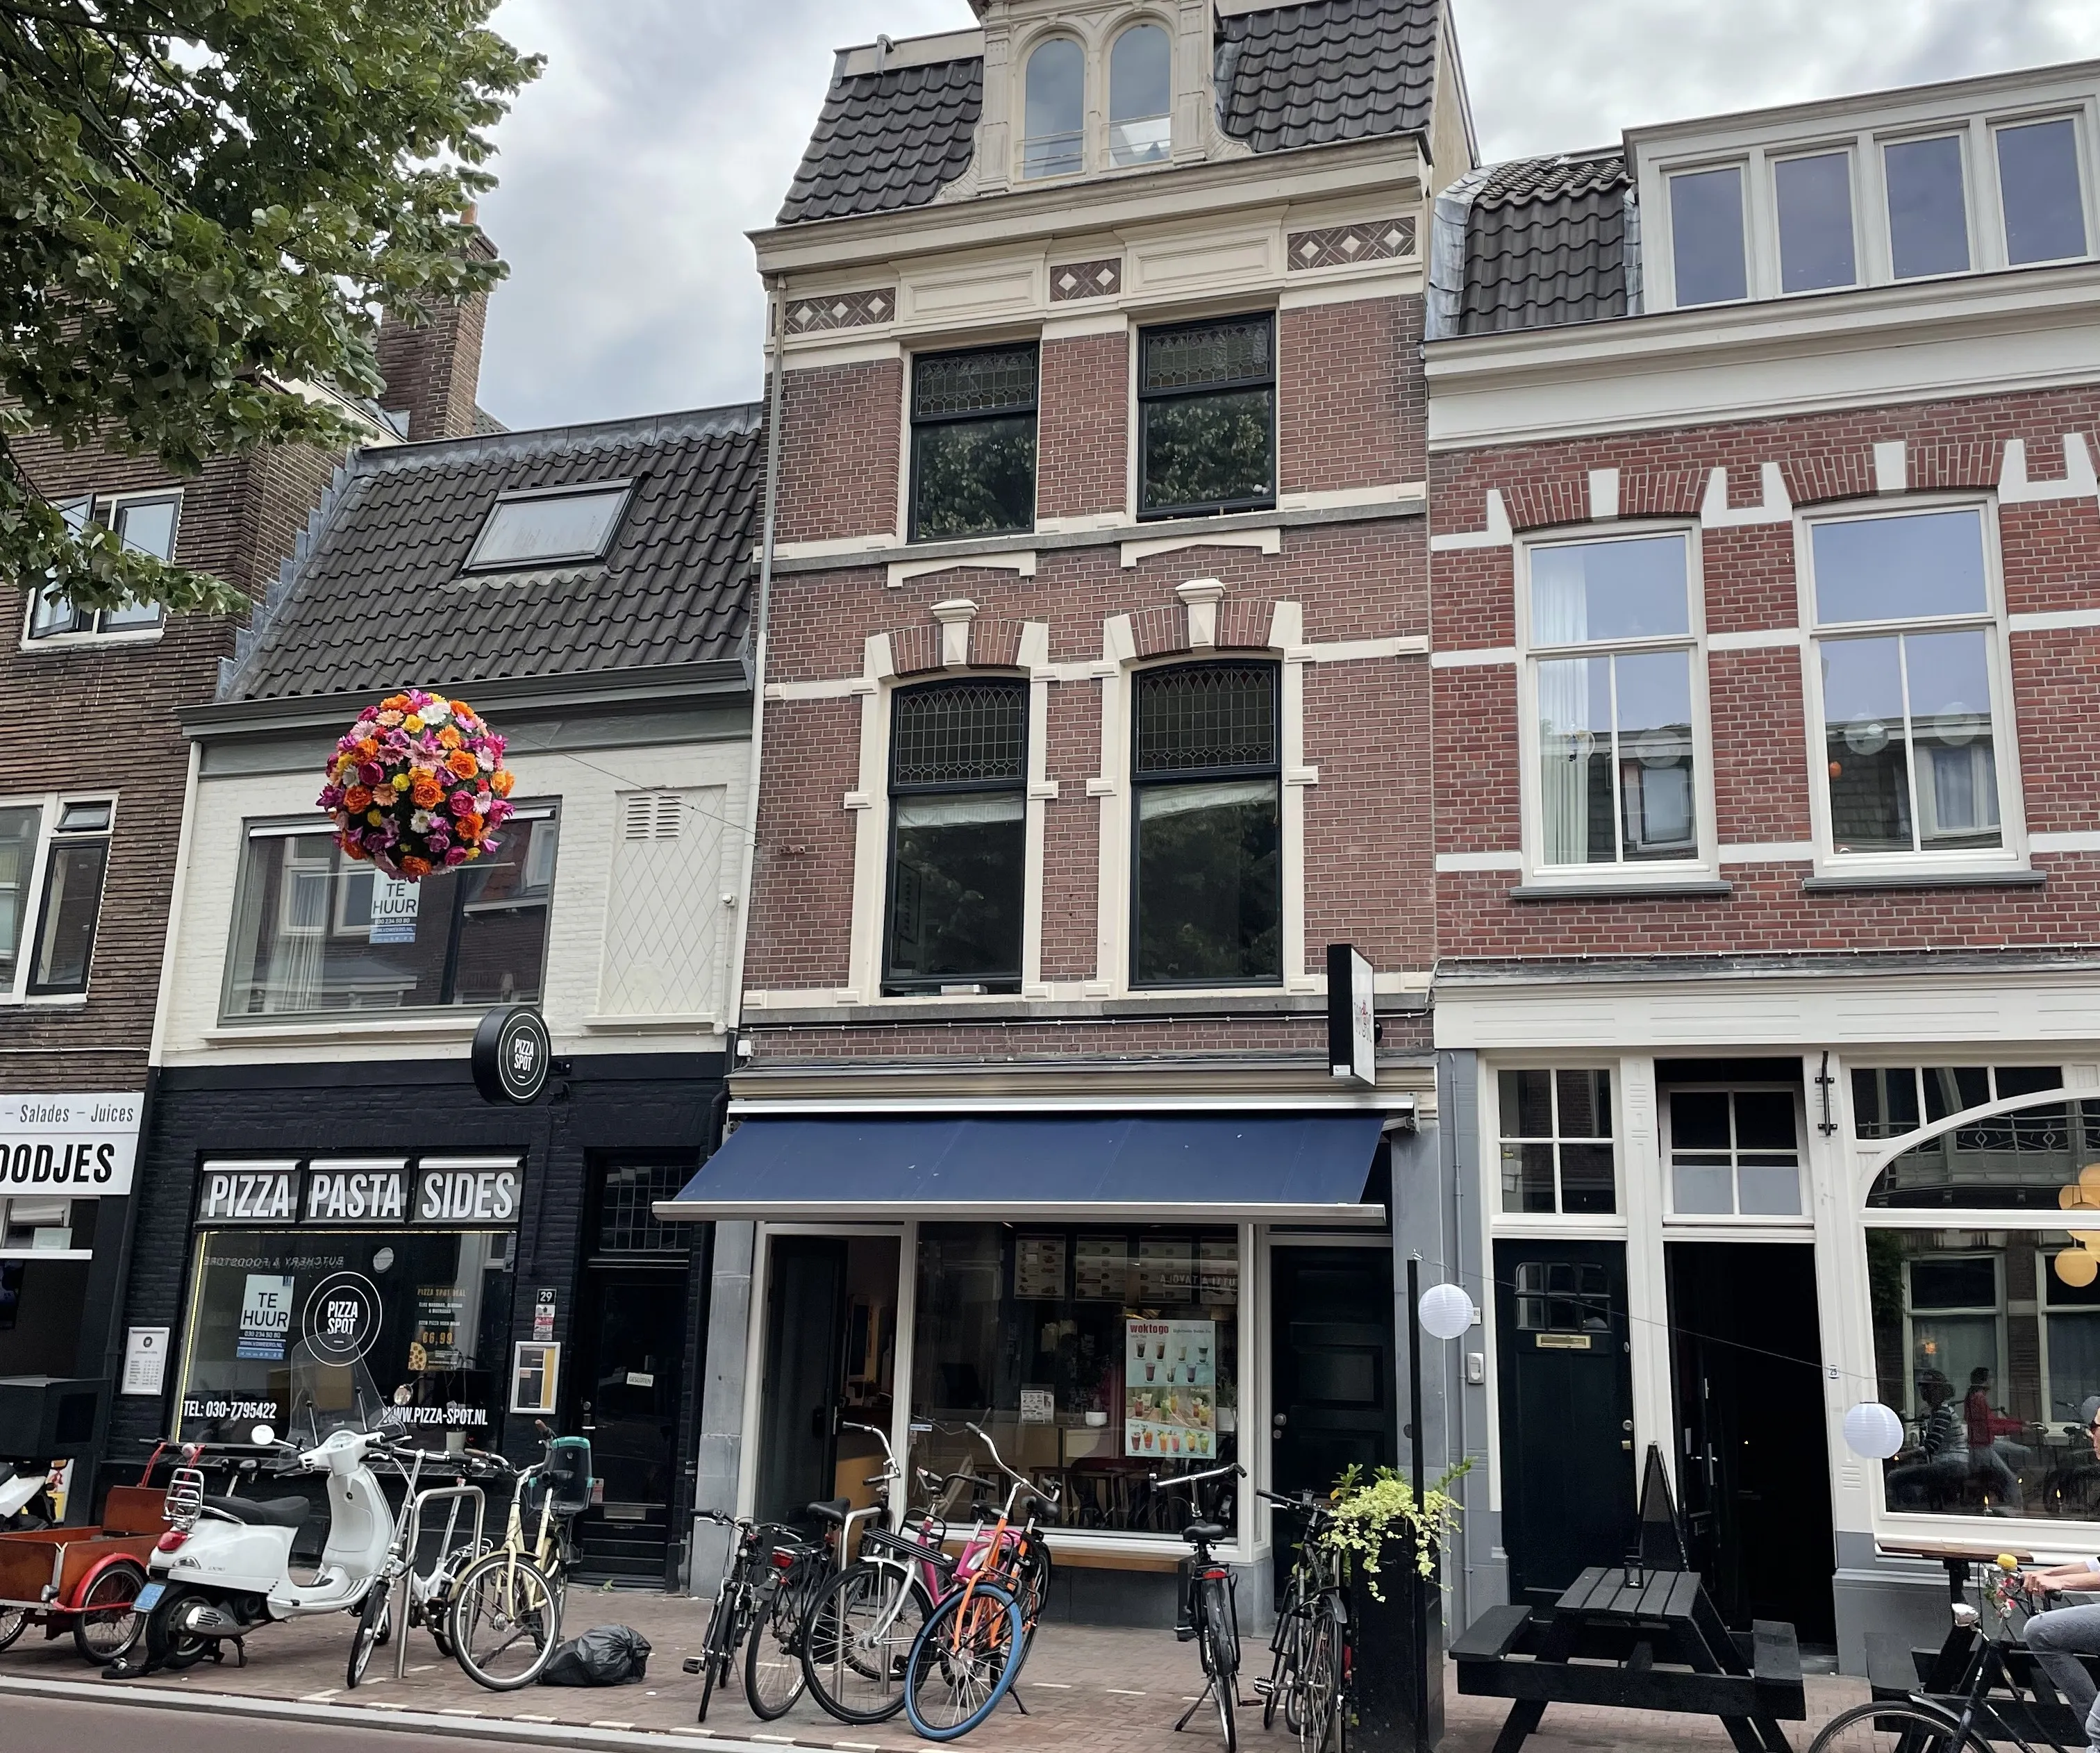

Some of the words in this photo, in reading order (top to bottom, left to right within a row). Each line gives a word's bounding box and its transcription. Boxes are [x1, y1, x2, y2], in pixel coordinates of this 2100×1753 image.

[386, 883, 406, 897] TE
[373, 899, 417, 915] HUUR
[514, 1038, 534, 1057] PIZZA
[514, 1054, 533, 1071] SPOT
[20, 1104, 69, 1122] Salades
[90, 1103, 133, 1122] Juices
[208, 1174, 290, 1218] PIZZA
[309, 1173, 401, 1218] PASTA
[422, 1172, 515, 1219] SIDES
[258, 1293, 278, 1308] TE
[540, 1291, 553, 1302] 29
[327, 1301, 358, 1318] PIZZA
[242, 1310, 288, 1327] HUUR
[326, 1318, 356, 1335] SPOT
[184, 1400, 203, 1417] TEL:
[206, 1401, 277, 1419] 030-7795422
[381, 1406, 488, 1425] WWW.PIZZA-SPOT.NL
